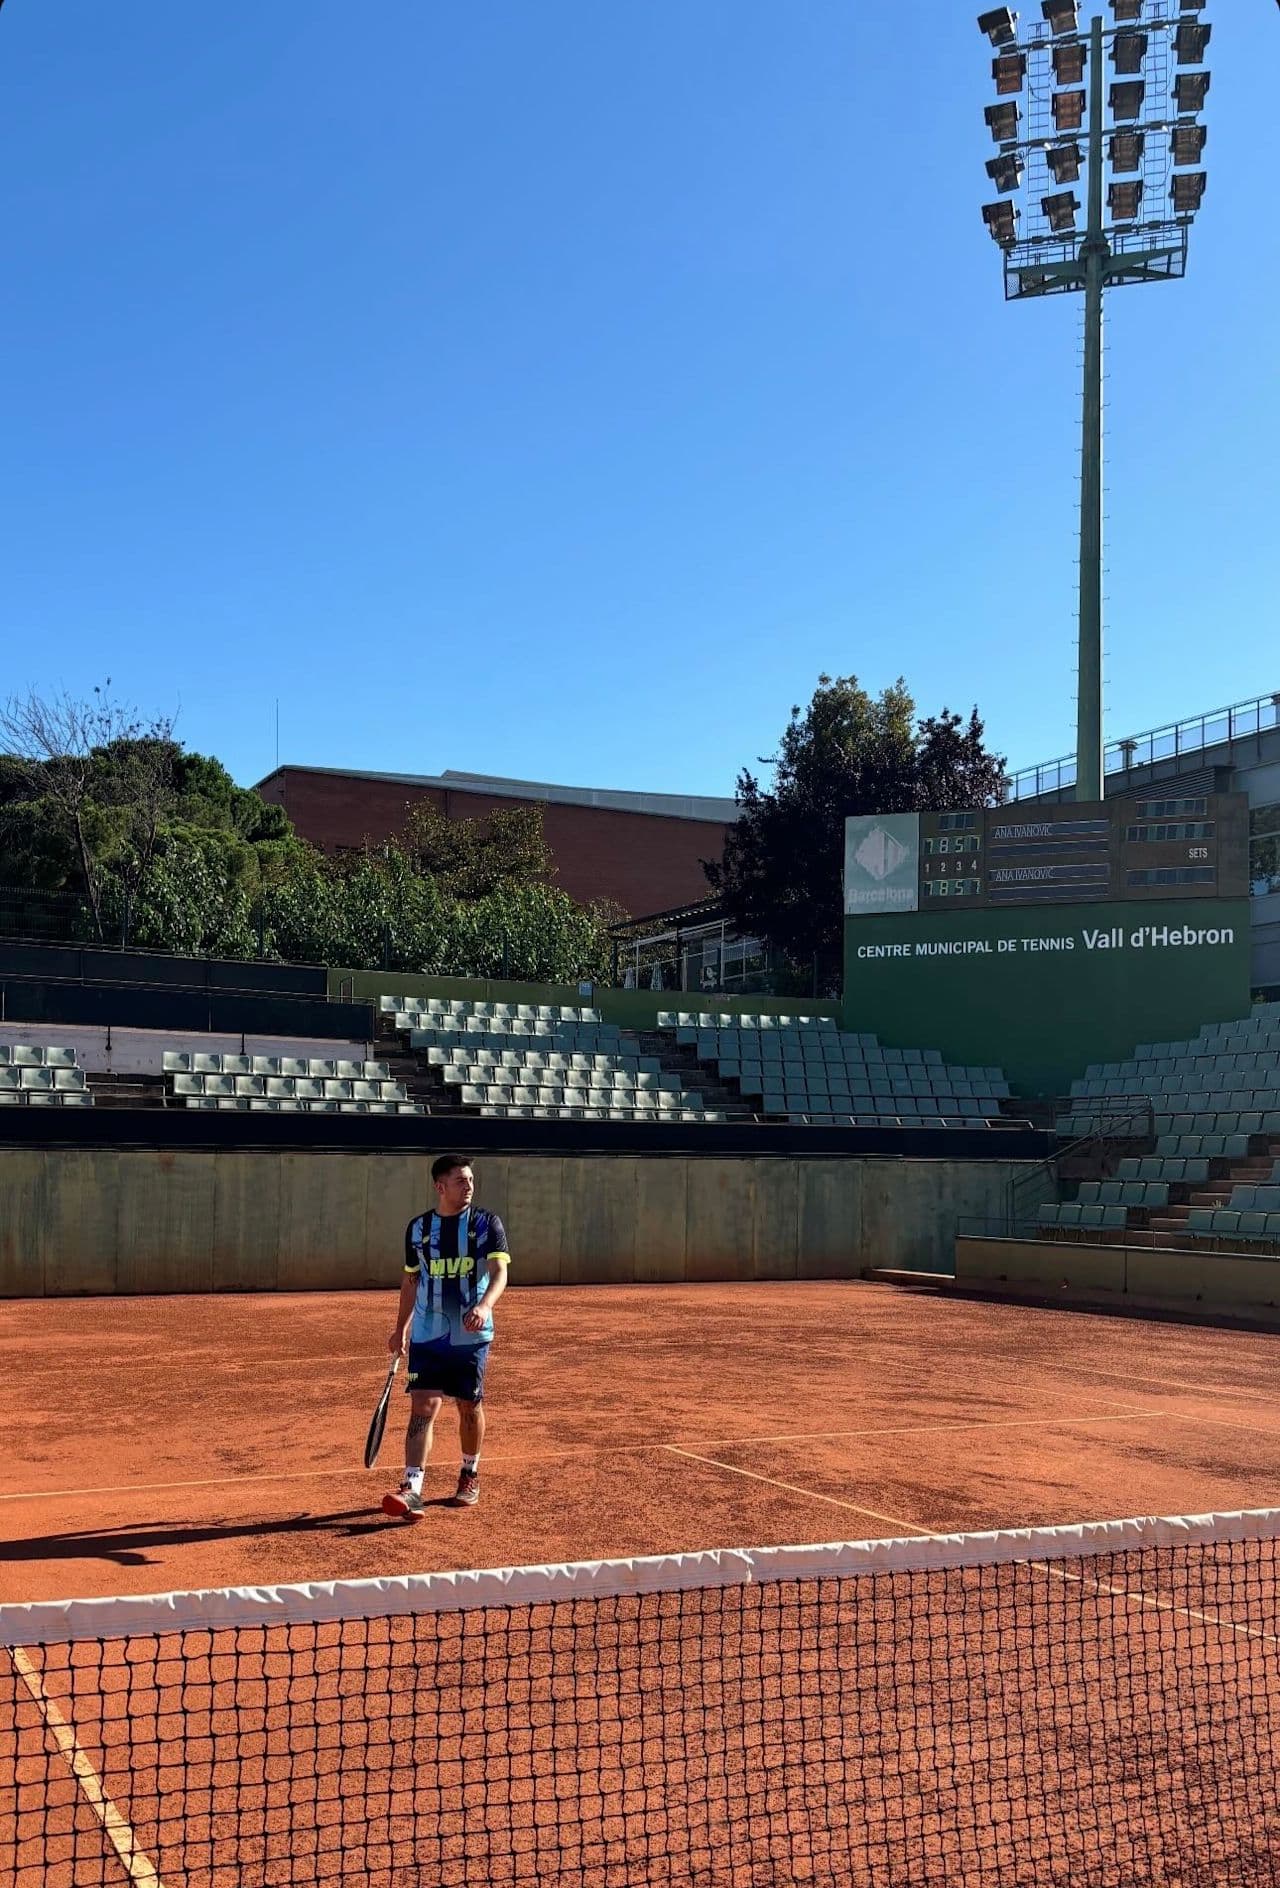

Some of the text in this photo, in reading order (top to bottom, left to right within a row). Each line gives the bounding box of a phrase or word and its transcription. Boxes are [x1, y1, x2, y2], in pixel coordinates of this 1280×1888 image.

[995, 828, 1014, 839] ANA
[1188, 848, 1208, 859] SETS
[925, 860, 978, 873] 1 2 3 4
[996, 871, 1013, 881] ANA
[848, 887, 915, 904] Barcelona
[857, 944, 912, 959] CENTRE
[915, 940, 994, 956] MUNICIPAL
[997, 938, 1018, 953] DE
[1021, 936, 1075, 952] TENNIS
[1082, 928, 1124, 950] Vall
[429, 1256, 475, 1279] MVP
